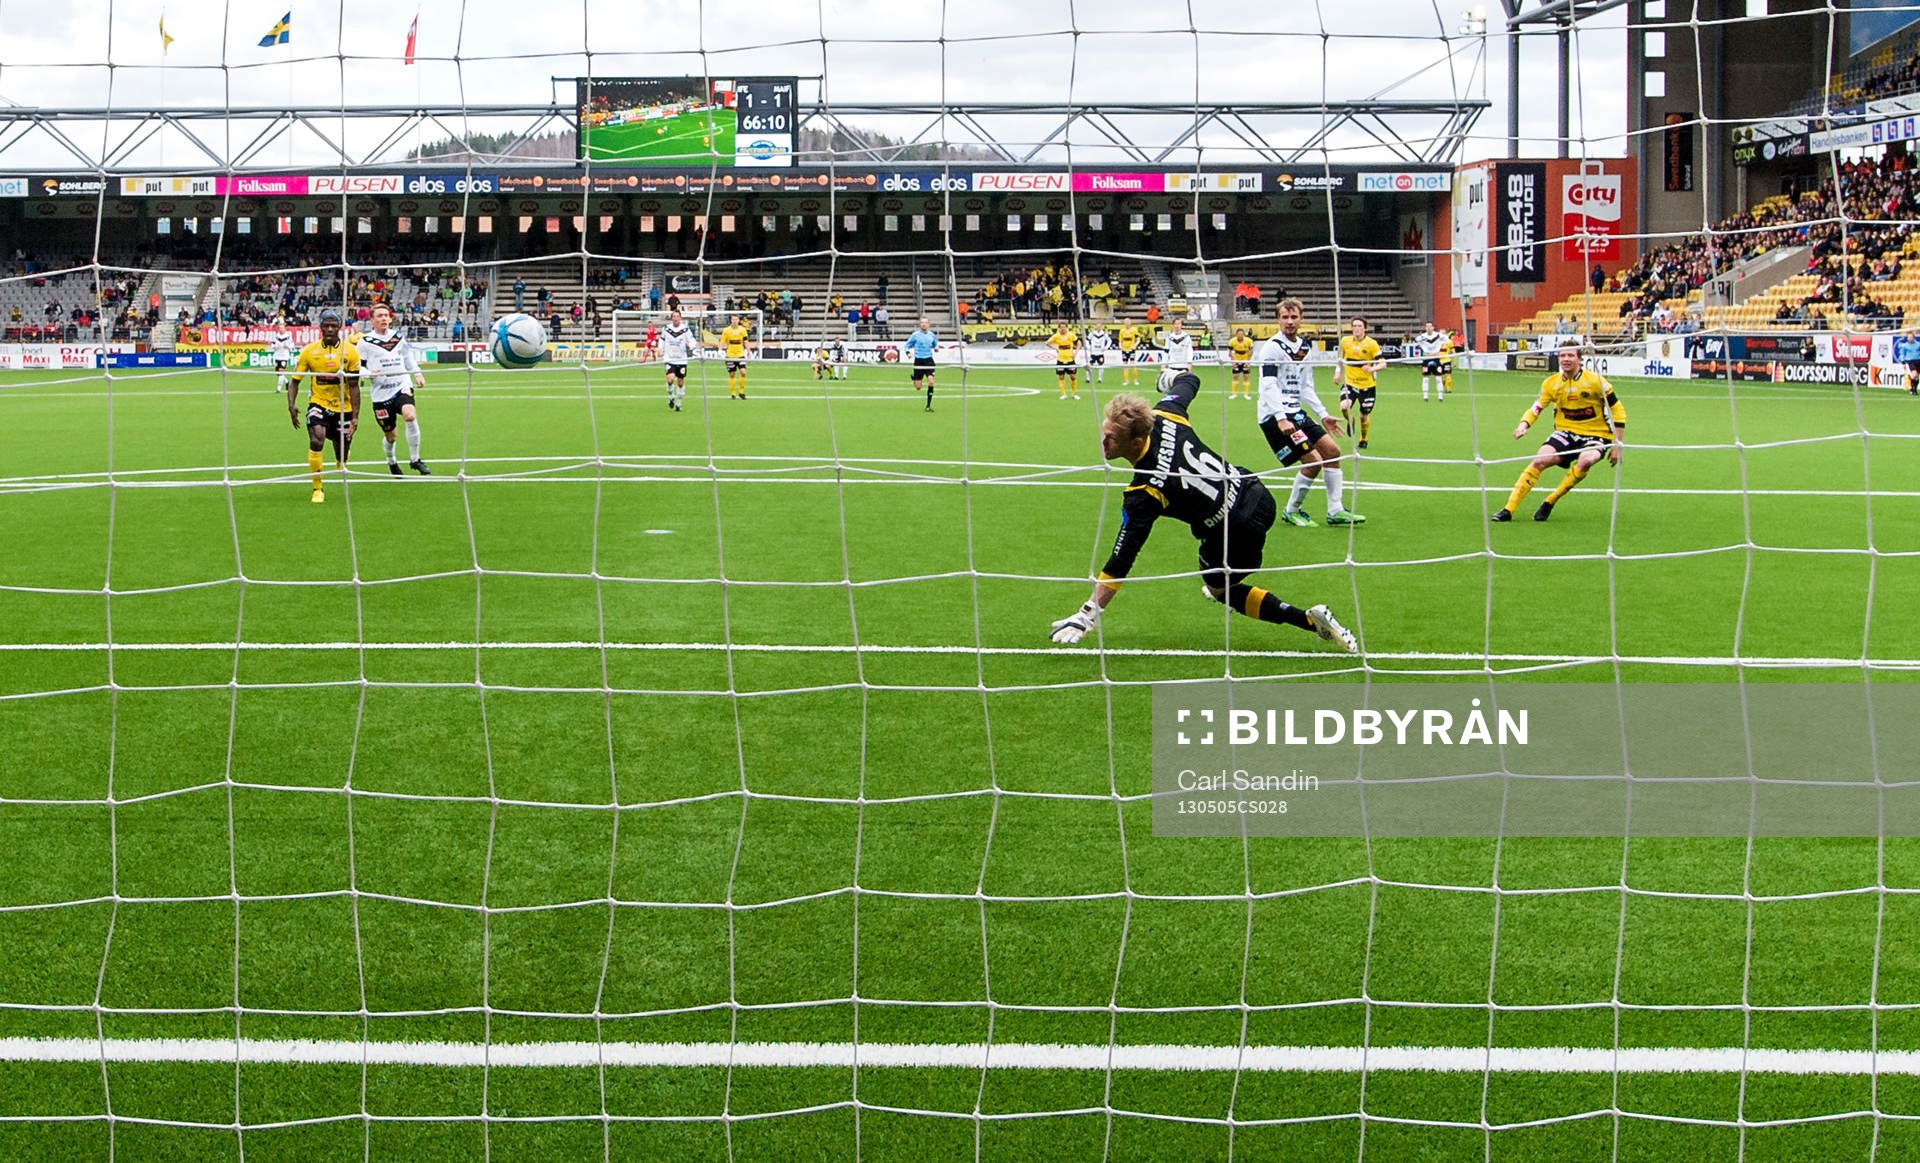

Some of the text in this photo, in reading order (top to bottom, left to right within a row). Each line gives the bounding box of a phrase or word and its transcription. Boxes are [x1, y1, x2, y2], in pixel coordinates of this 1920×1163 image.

[745, 93, 753, 108] 1
[774, 93, 781, 108] 1
[742, 115, 785, 129] 66:10
[145, 180, 162, 194] put
[192, 180, 209, 194] put
[238, 179, 287, 193] Folksam
[314, 178, 398, 192] PULSEN
[408, 175, 445, 193] ellos
[455, 175, 492, 193] ellos
[883, 173, 920, 191] ellos
[930, 173, 968, 191] ellos
[979, 175, 1064, 189] PULSEN
[1092, 176, 1142, 189] Folksam
[1190, 176, 1207, 190] put
[1238, 176, 1255, 190] put
[1469, 177, 1484, 210] put
[1508, 173, 1524, 272] 8848
[1523, 173, 1535, 272] ALTITUDE
[224, 352, 248, 366] GP
[1644, 359, 1674, 376] stiba
[1784, 364, 1868, 384] OLOFSSON BYGG
[1177, 440, 1225, 502] 16
